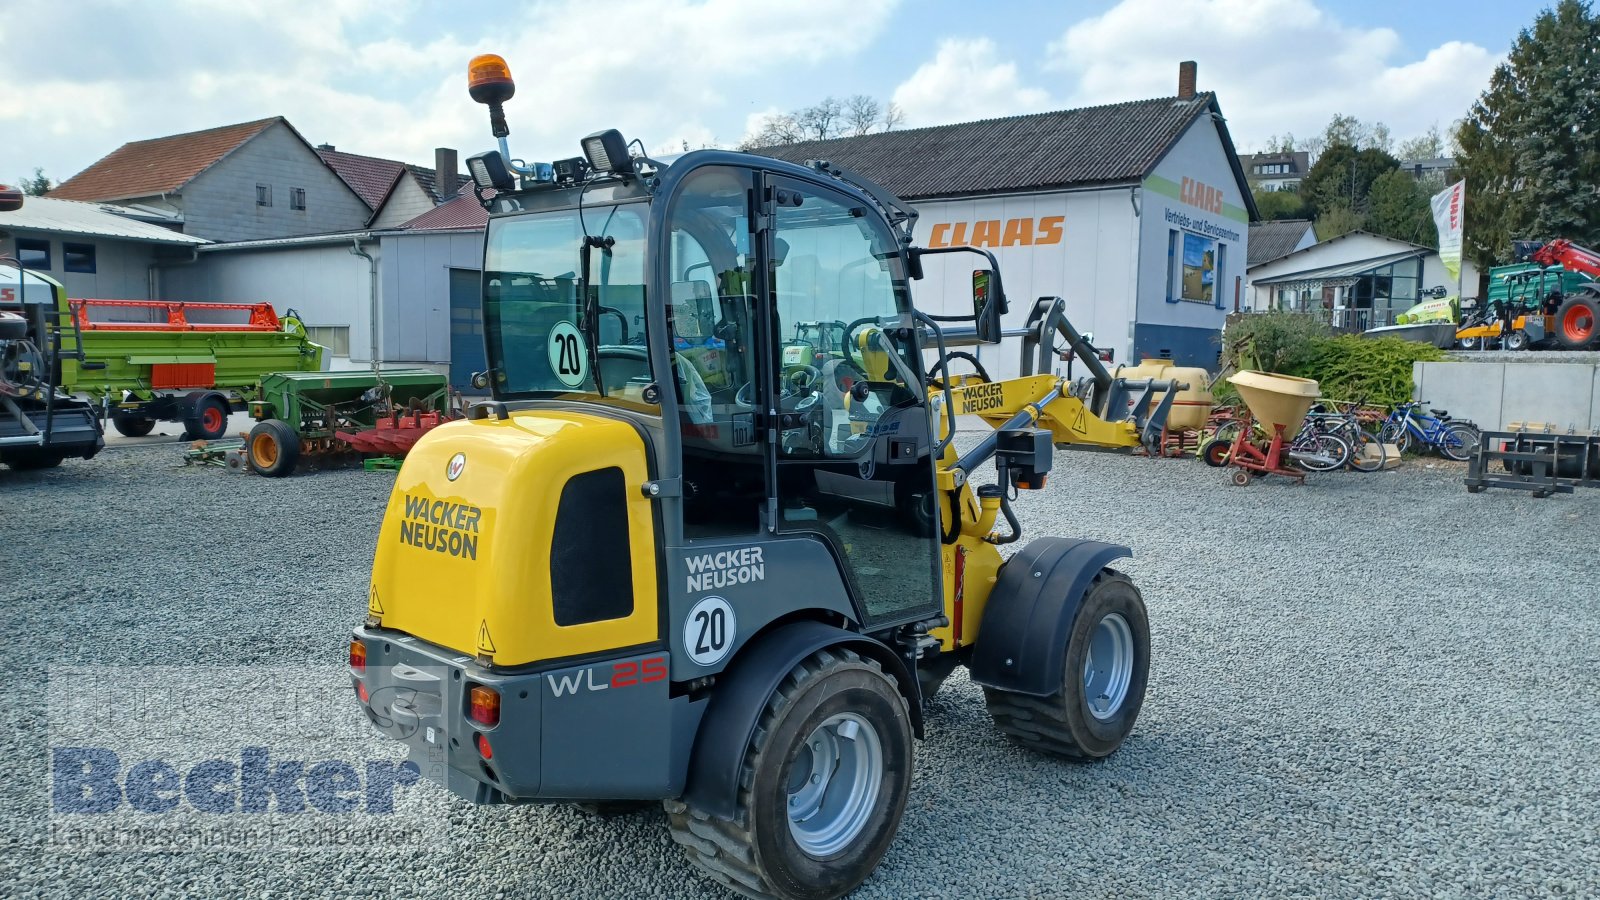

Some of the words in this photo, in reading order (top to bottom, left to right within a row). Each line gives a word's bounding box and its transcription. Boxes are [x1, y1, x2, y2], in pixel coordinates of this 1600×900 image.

[1180, 176, 1223, 214] CLAAS
[928, 216, 1065, 248] CLAAS
[1164, 208, 1191, 227] Vertriebs-
[1192, 220, 1203, 231] und
[1203, 220, 1240, 241] Servicezentrum
[555, 333, 581, 375] 20
[962, 396, 1004, 413] NEUSON
[963, 383, 1003, 402] WACKER
[405, 494, 481, 533] WACKER
[400, 520, 478, 561] NEUSON
[685, 546, 764, 574] WACKER
[686, 563, 765, 593] NEUSON
[694, 607, 725, 655] 20
[547, 657, 667, 698] WL25
